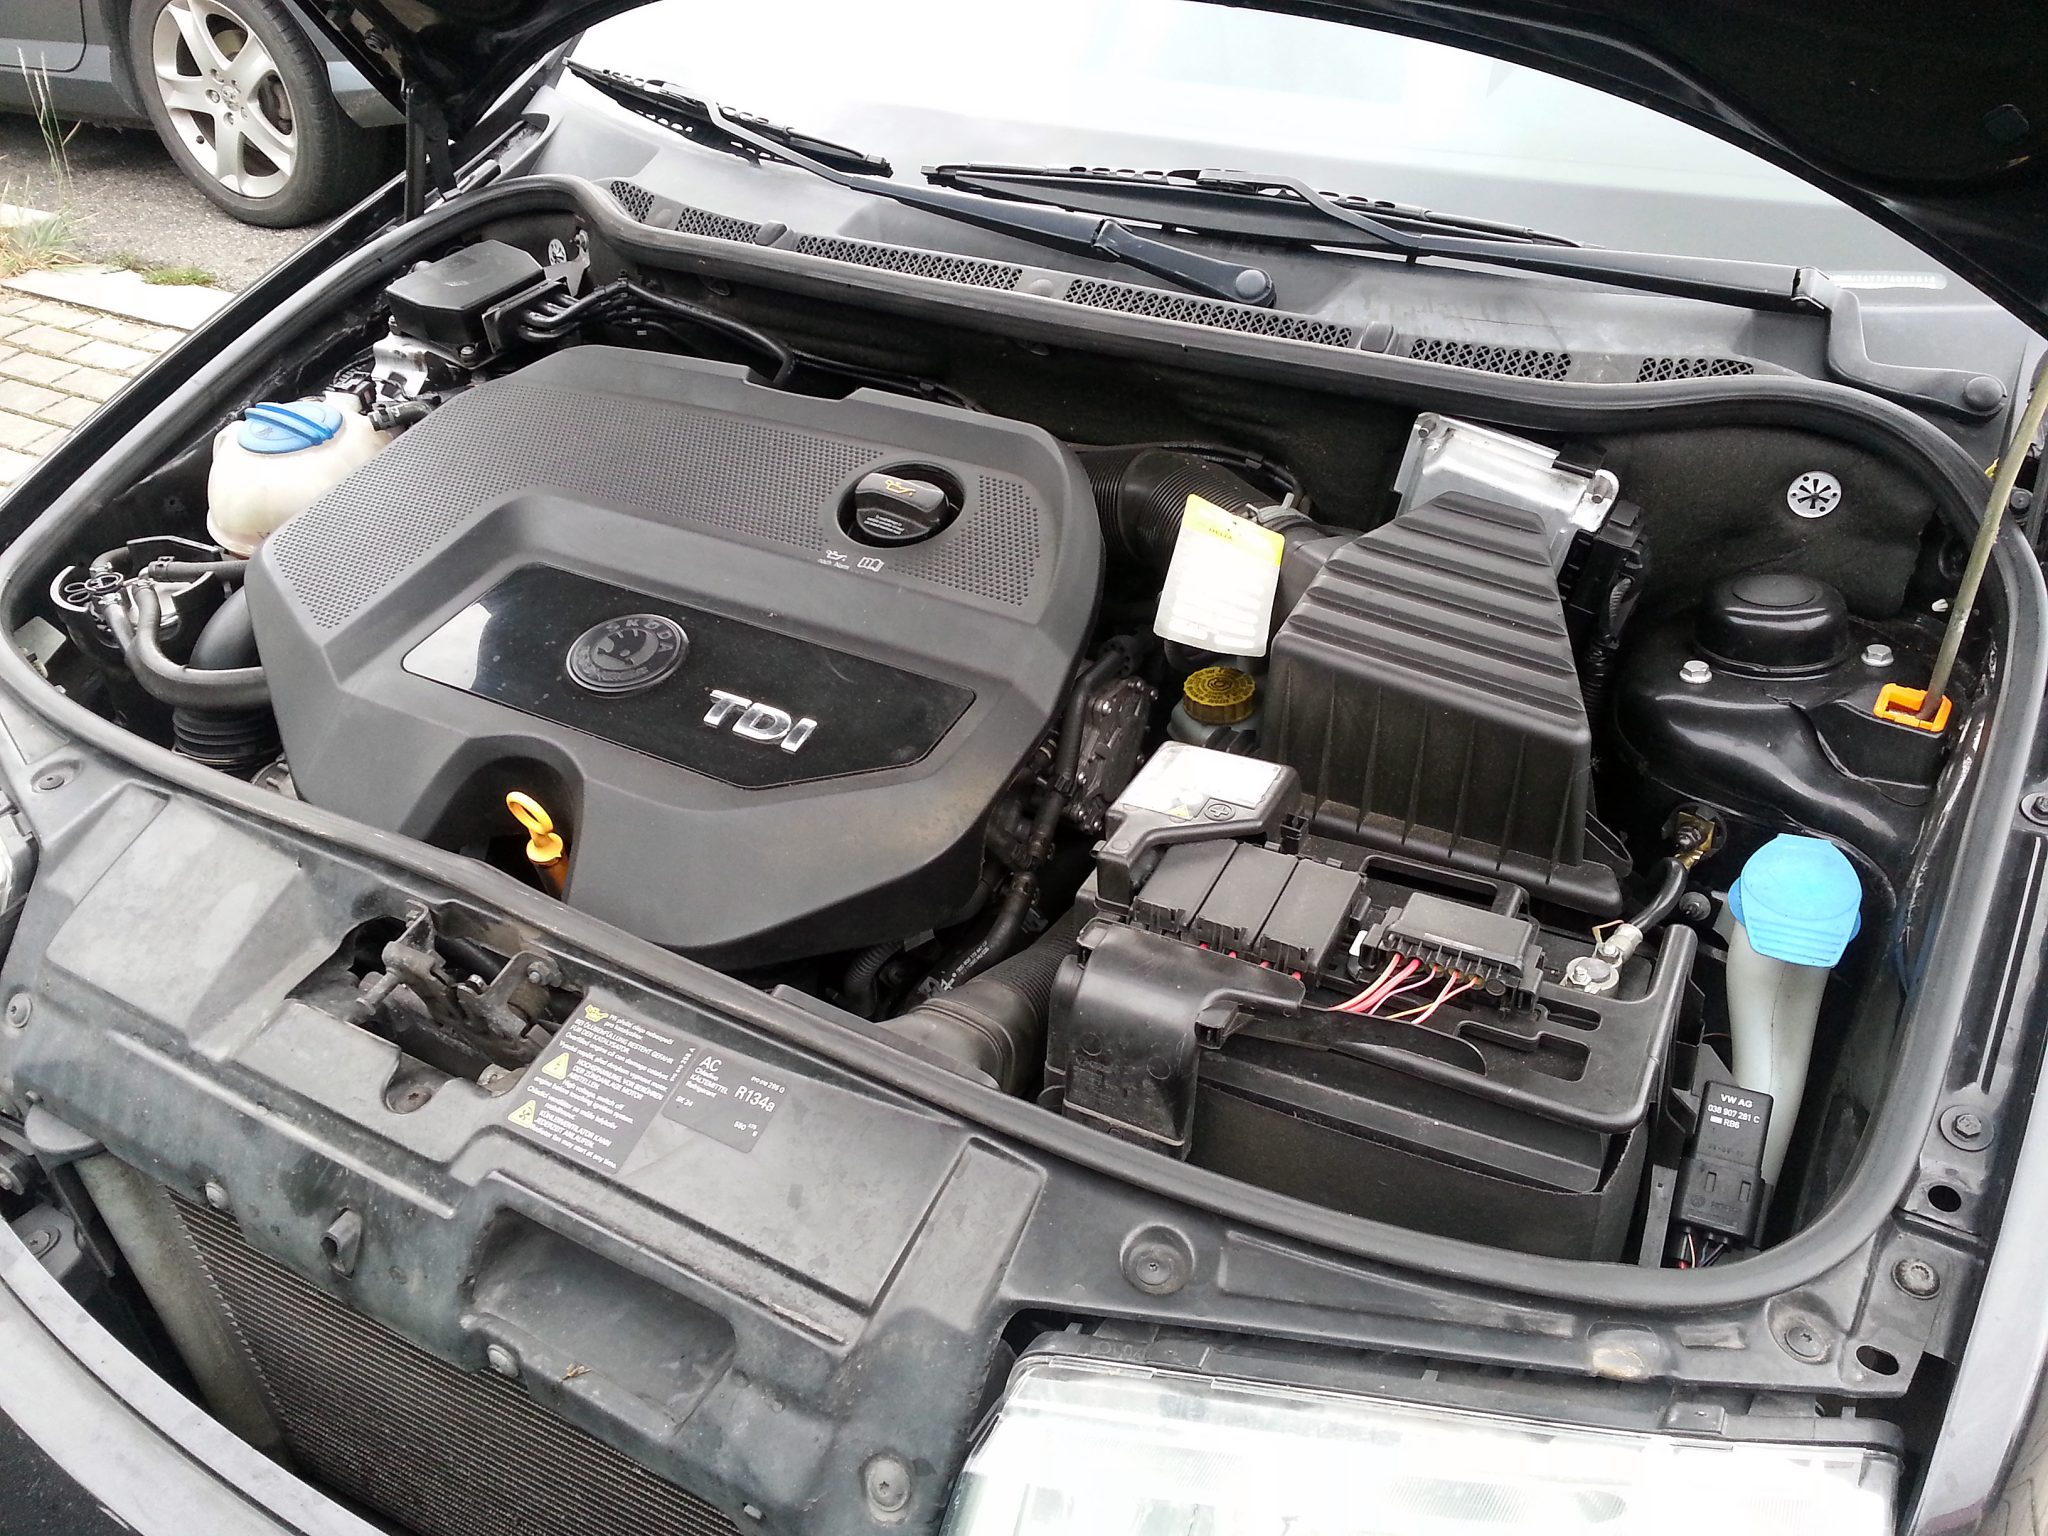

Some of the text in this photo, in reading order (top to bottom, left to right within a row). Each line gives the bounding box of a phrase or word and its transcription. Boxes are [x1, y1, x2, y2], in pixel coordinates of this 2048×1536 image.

[703, 690, 817, 753] TDI
[699, 1056, 722, 1072] AC
[734, 1085, 776, 1112] R134a
[1720, 1093, 1753, 1108] VW AG
[1707, 1104, 1722, 1114] 038
[1723, 1107, 1737, 1118] 907
[1753, 1115, 1761, 1124] C
